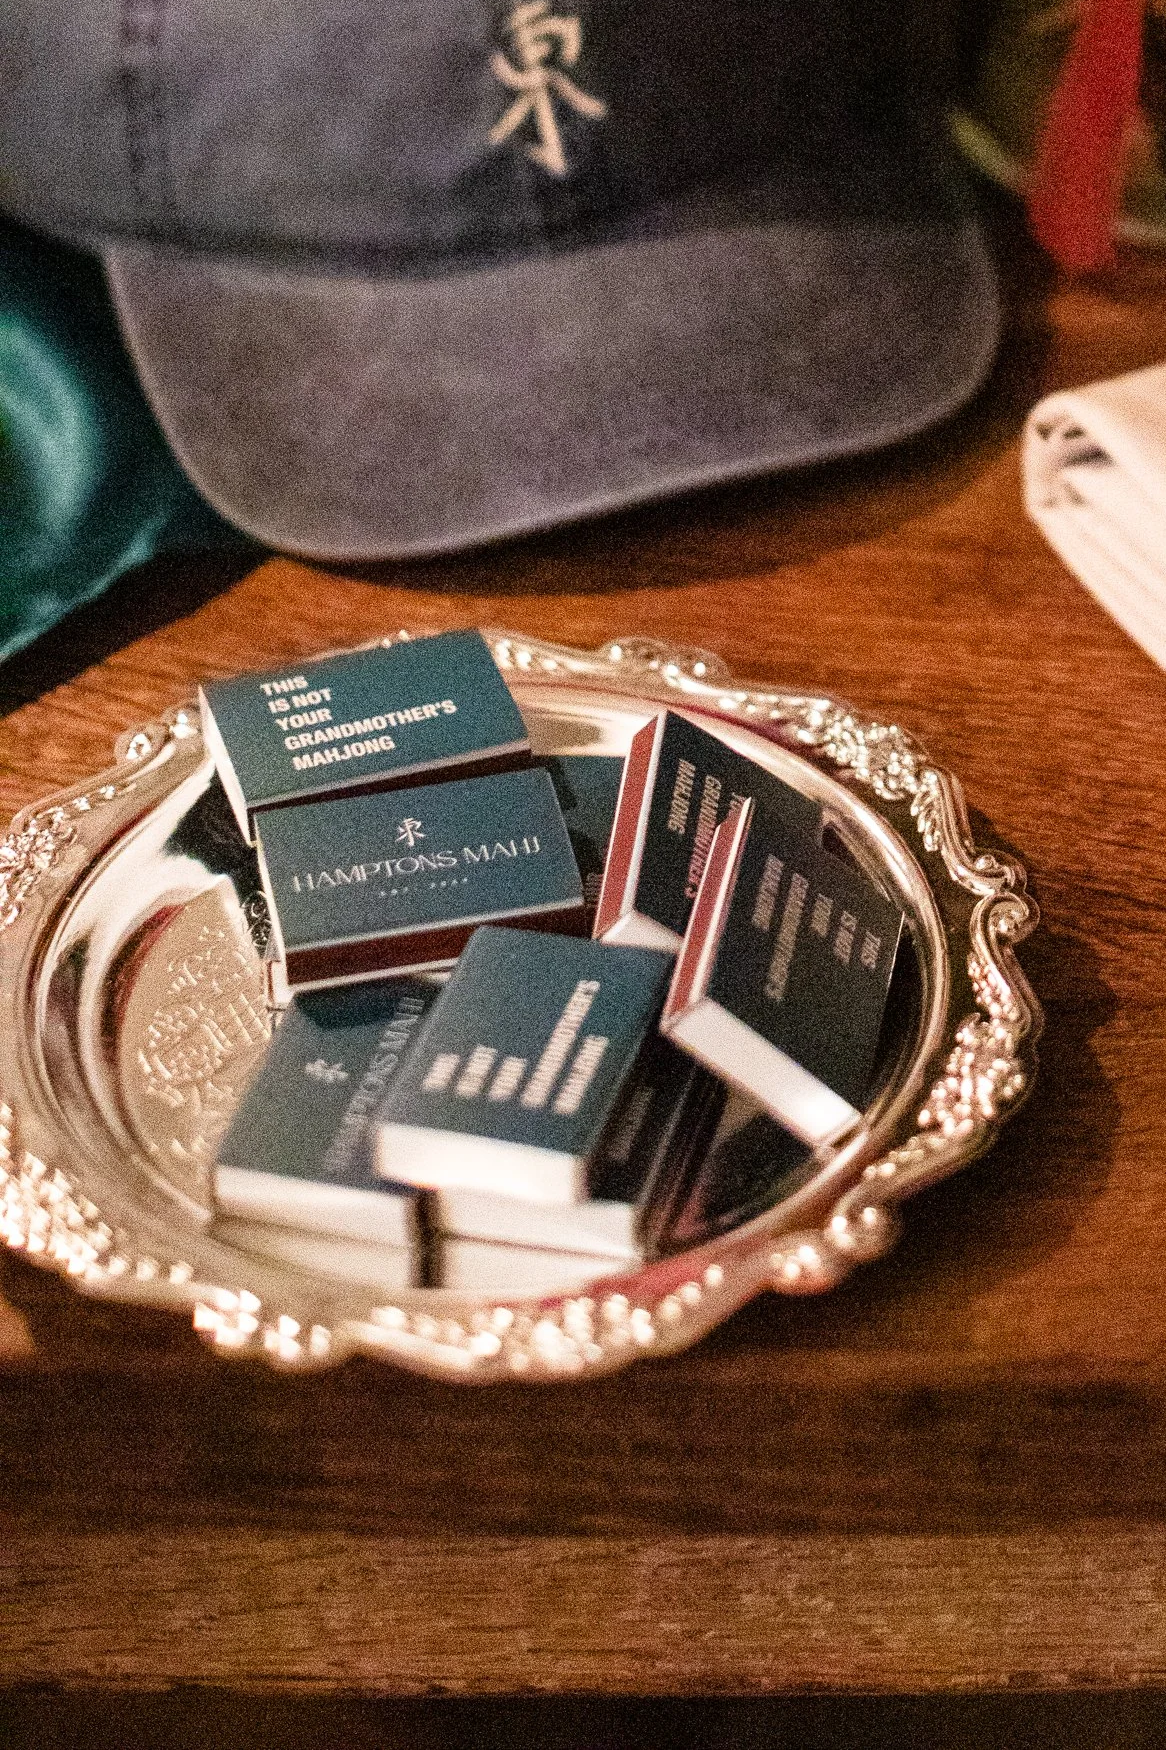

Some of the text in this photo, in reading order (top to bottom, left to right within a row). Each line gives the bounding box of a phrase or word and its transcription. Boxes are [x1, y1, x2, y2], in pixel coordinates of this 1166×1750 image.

[259, 675, 309, 697] THIS
[268, 687, 332, 714] IS NOT
[275, 707, 333, 731] YOUR
[284, 699, 459, 751] GRANDMOTHER'S
[292, 735, 396, 771] MAHJONG
[667, 758, 696, 834] MAHJONG
[293, 850, 458, 894] HAMPTONS
